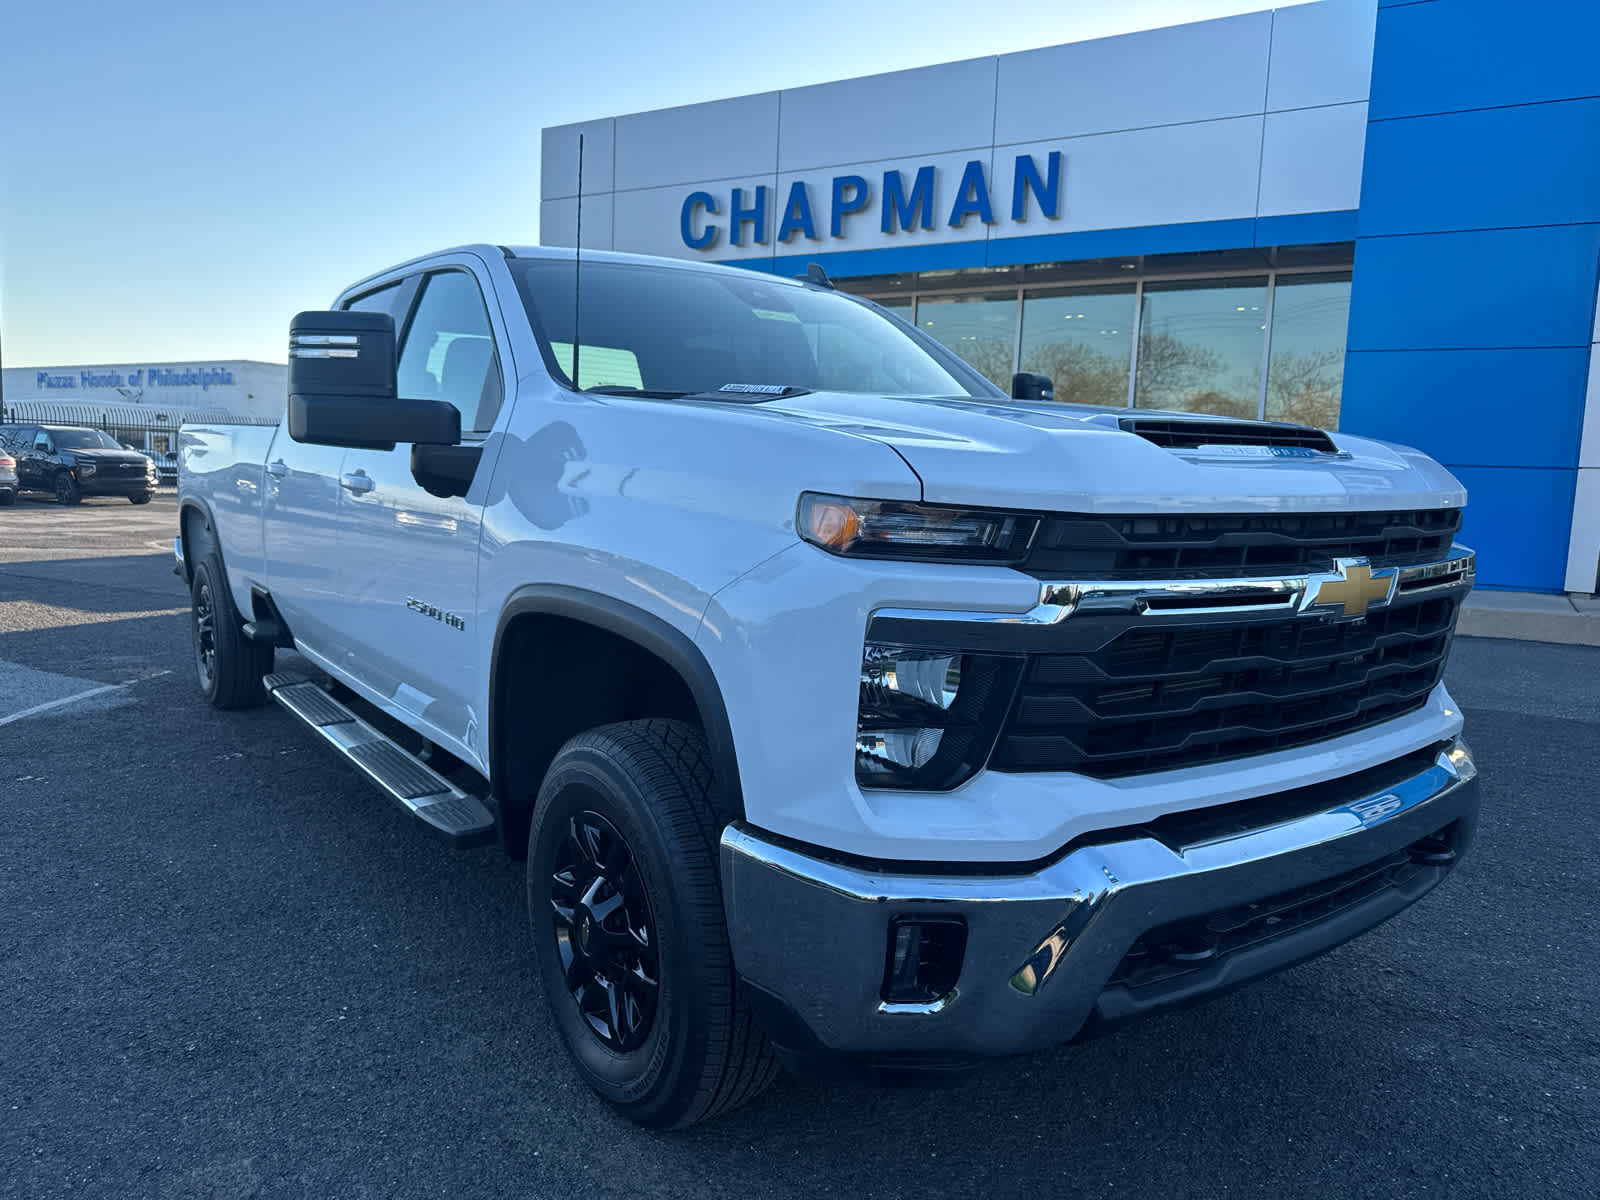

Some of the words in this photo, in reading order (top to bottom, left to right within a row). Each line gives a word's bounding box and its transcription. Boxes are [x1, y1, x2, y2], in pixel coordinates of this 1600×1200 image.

[680, 151, 1063, 250] CHAPMAN
[80, 370, 124, 388] Honda
[128, 369, 144, 387] of
[148, 367, 234, 391] Philadelphia
[445, 610, 465, 631] HD
